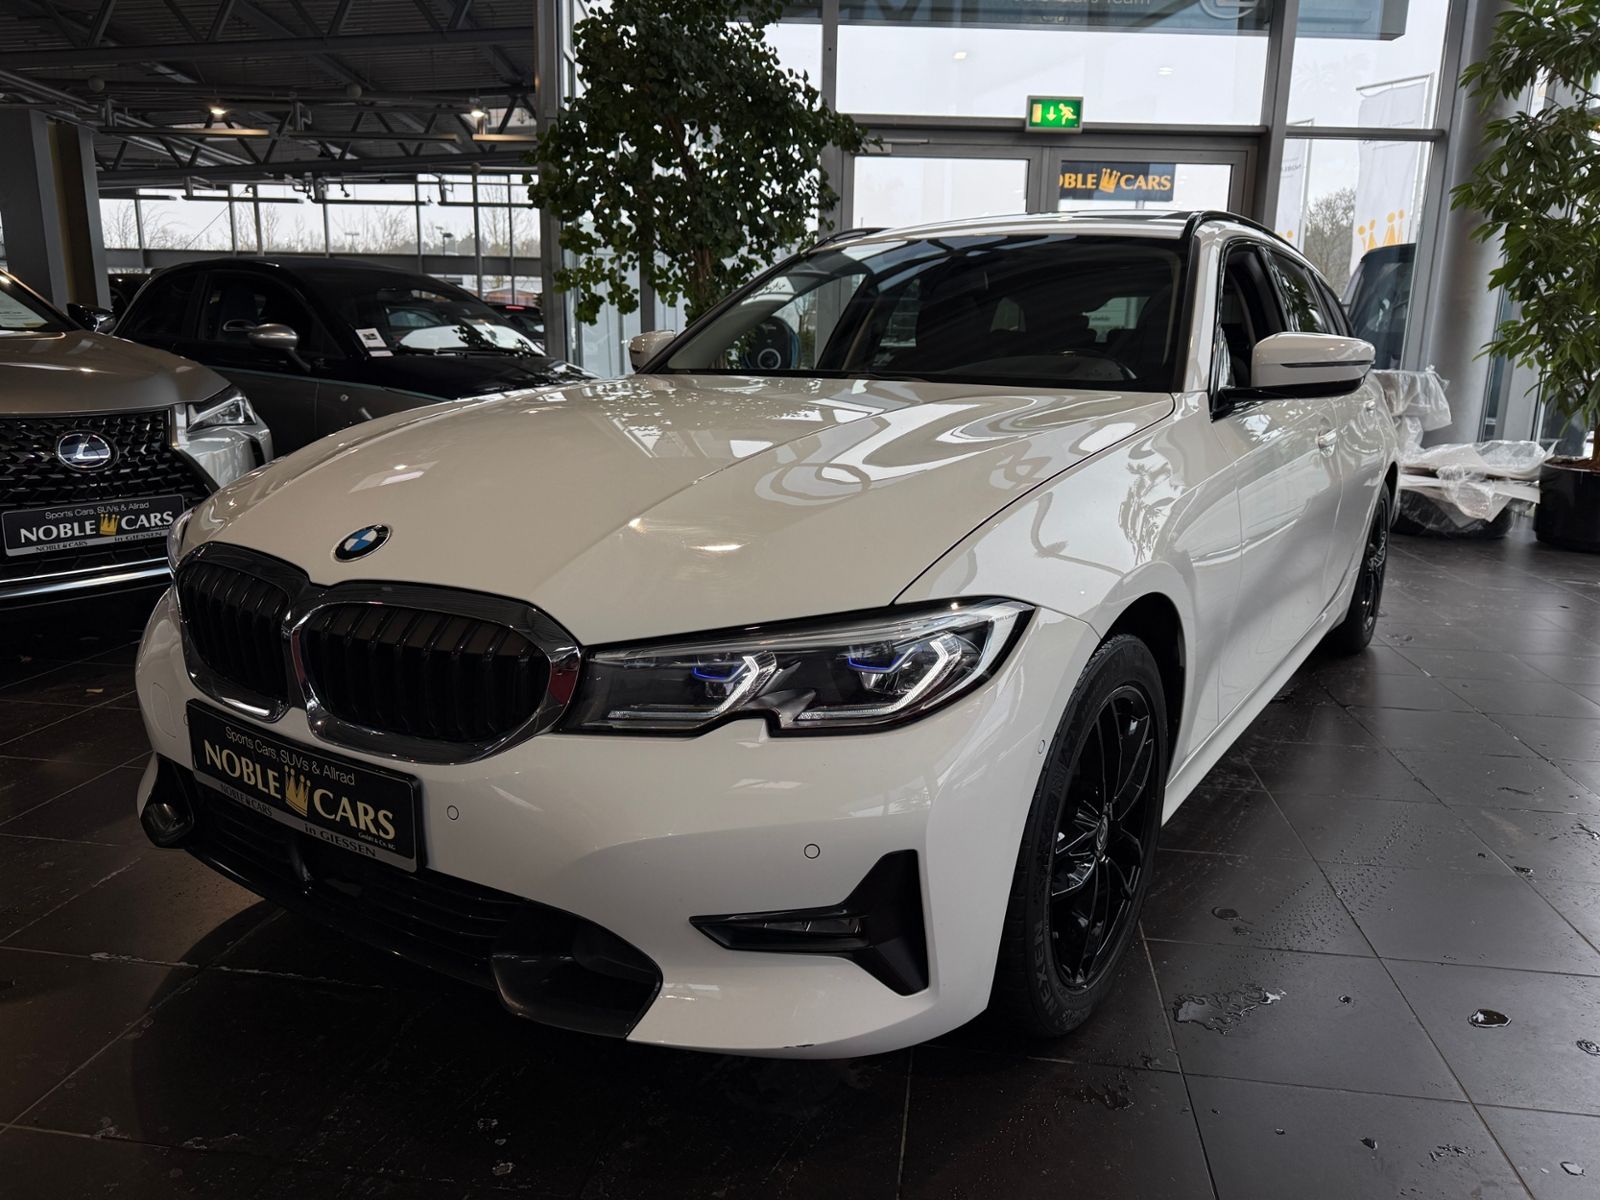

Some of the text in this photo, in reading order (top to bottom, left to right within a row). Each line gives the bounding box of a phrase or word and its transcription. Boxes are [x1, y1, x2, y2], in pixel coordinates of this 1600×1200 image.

[1059, 173, 1171, 190] BLE CARS
[20, 511, 174, 543] NOBLE CARS
[45, 511, 73, 520] Sports
[97, 505, 119, 513] SUVs
[128, 502, 149, 510] Allrad
[225, 726, 254, 750] Sports
[280, 749, 309, 771] SUVs
[311, 760, 320, 775] &
[323, 764, 355, 786] Allrad
[203, 739, 396, 840] NOBLE CARS
[304, 822, 377, 857] in GIESSEN
[1033, 920, 1058, 1016] NEXEN
